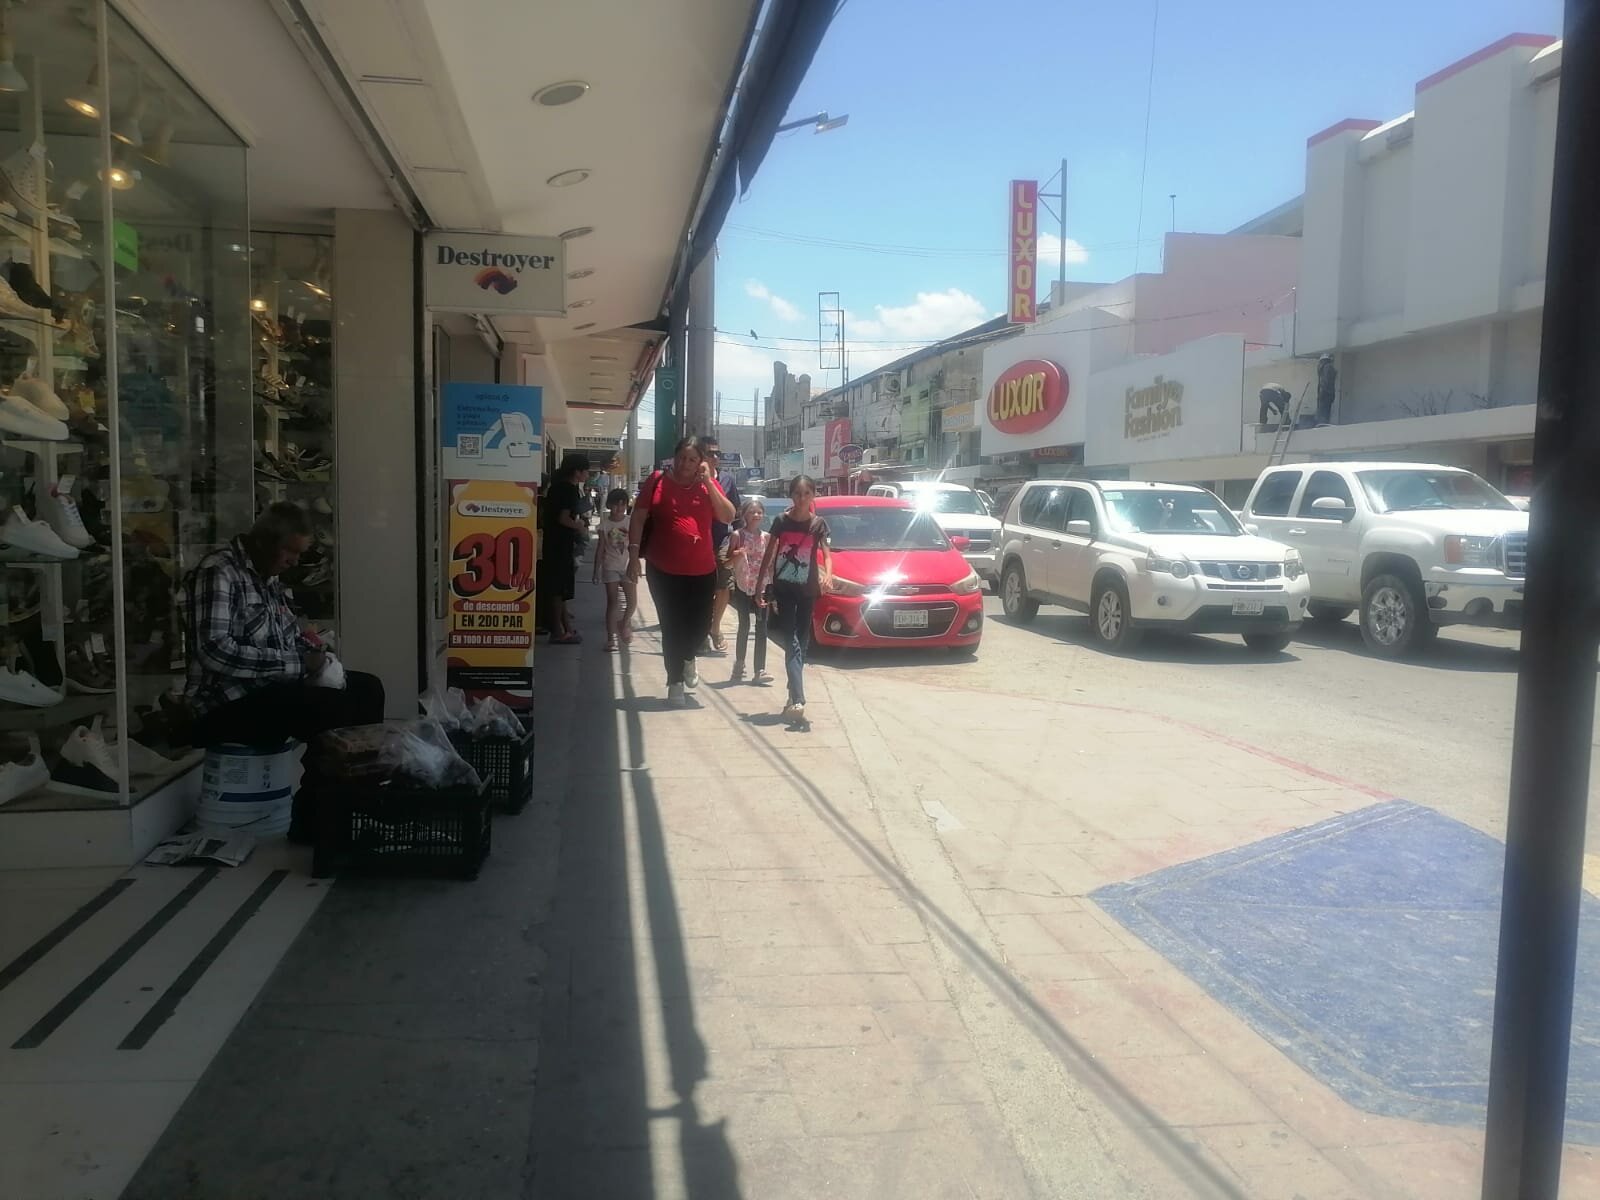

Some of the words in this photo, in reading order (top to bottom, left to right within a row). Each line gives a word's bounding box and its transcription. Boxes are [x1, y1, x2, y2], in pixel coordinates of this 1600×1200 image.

[1014, 183, 1034, 318] LUXOR
[437, 245, 555, 273] Destroyer
[989, 371, 1047, 421] LUXOR
[481, 504, 523, 515] Destroyer
[476, 601, 520, 612] descuento
[461, 614, 475, 628] EN
[478, 615, 499, 628] 2DO
[502, 615, 523, 628] PAR
[452, 634, 462, 645] EN
